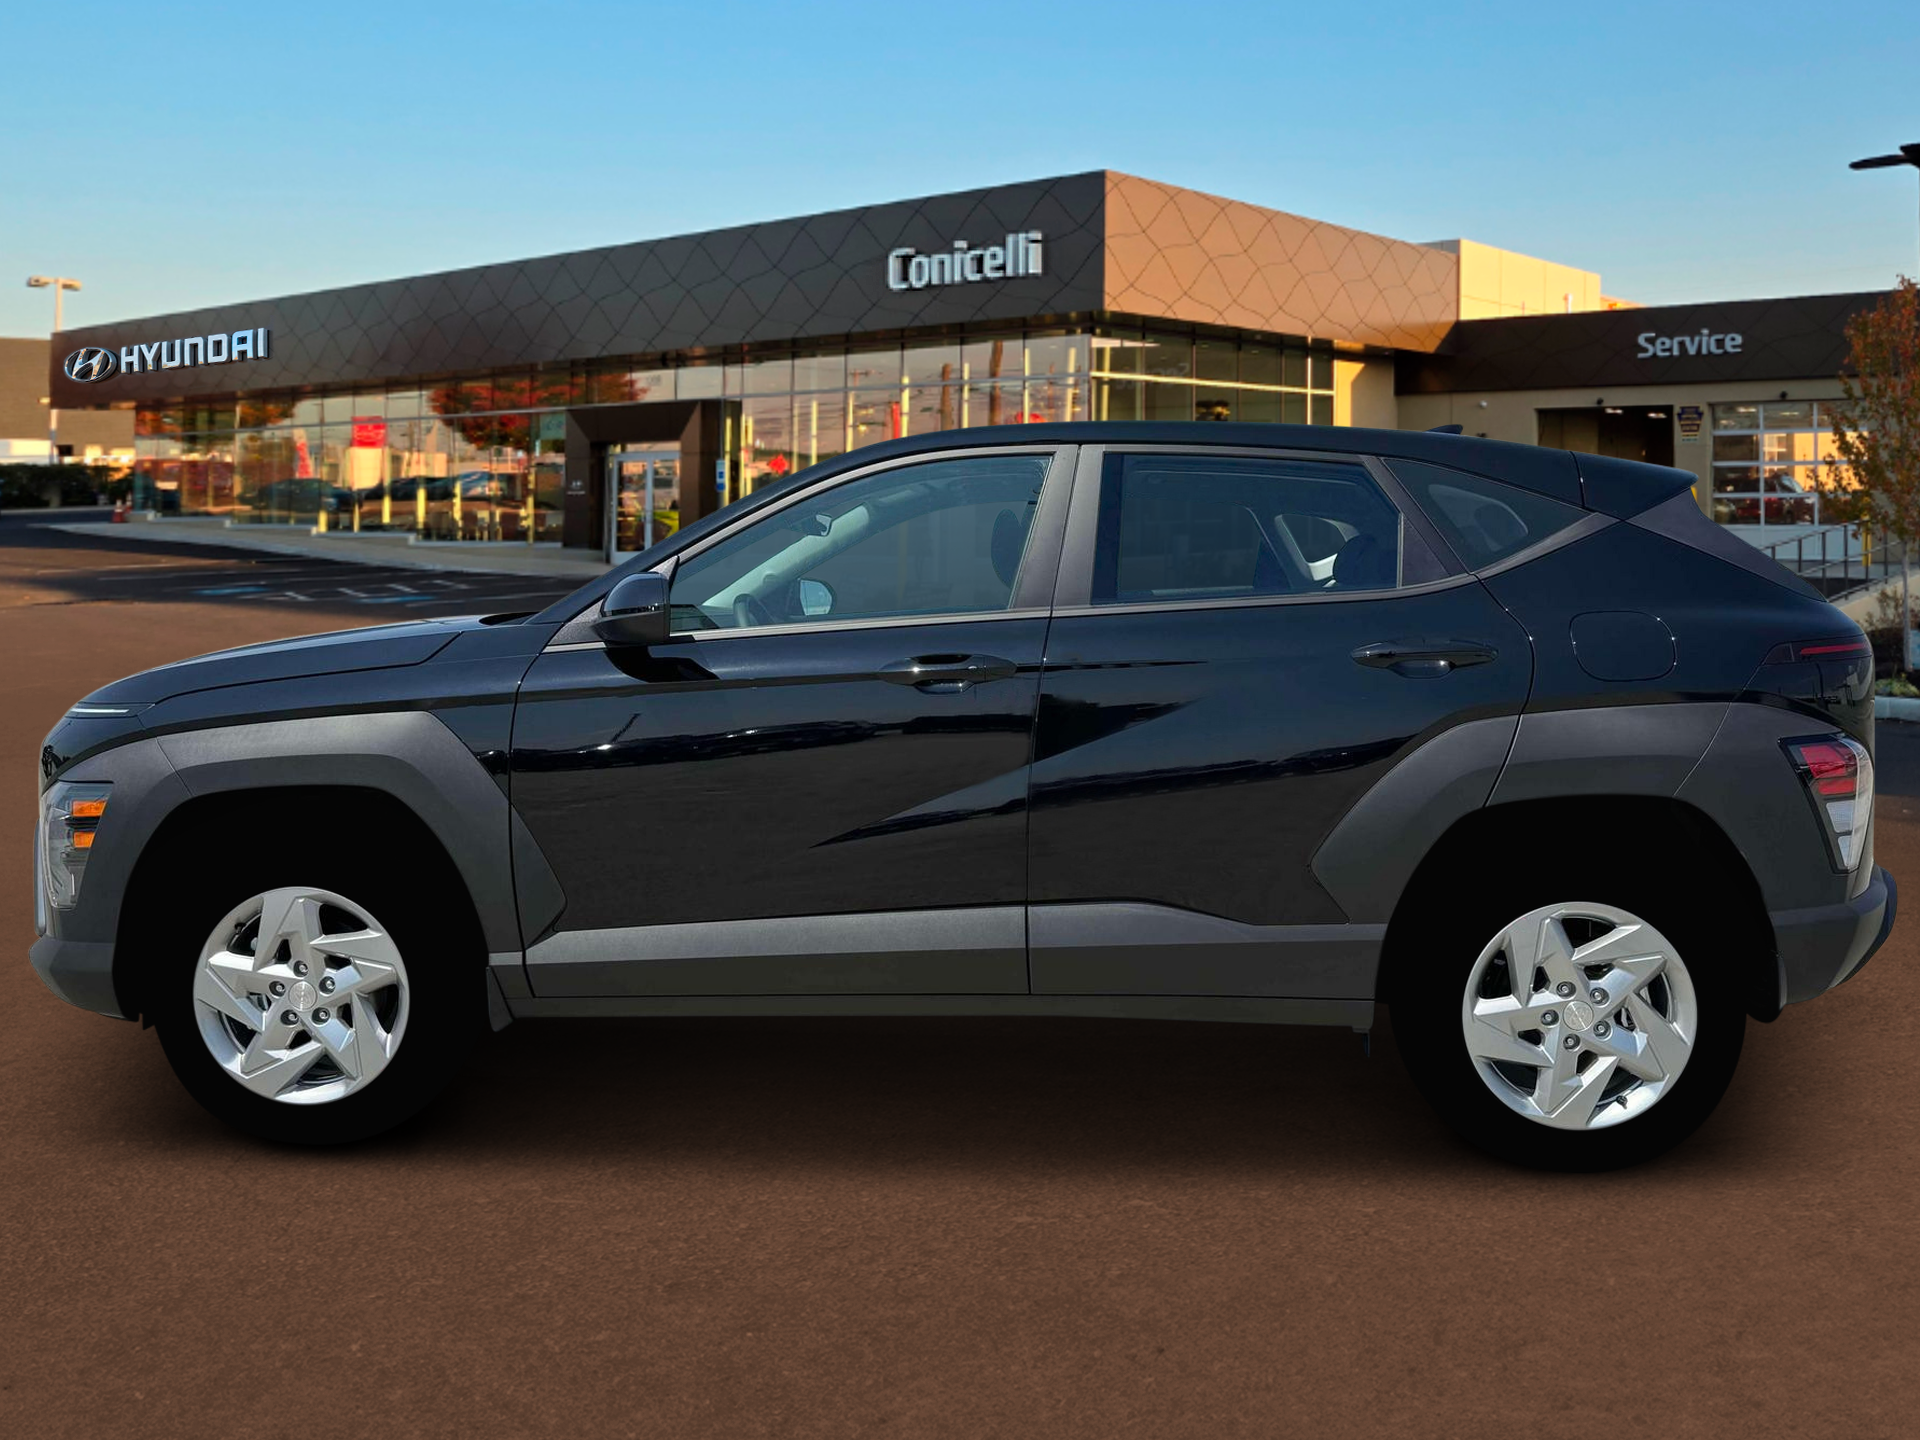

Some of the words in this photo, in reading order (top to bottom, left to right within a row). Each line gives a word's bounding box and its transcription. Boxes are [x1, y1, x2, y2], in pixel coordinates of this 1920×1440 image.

[888, 230, 1043, 290] Conicelli
[120, 327, 269, 373] HYUNDAI
[1637, 327, 1742, 358] Service
